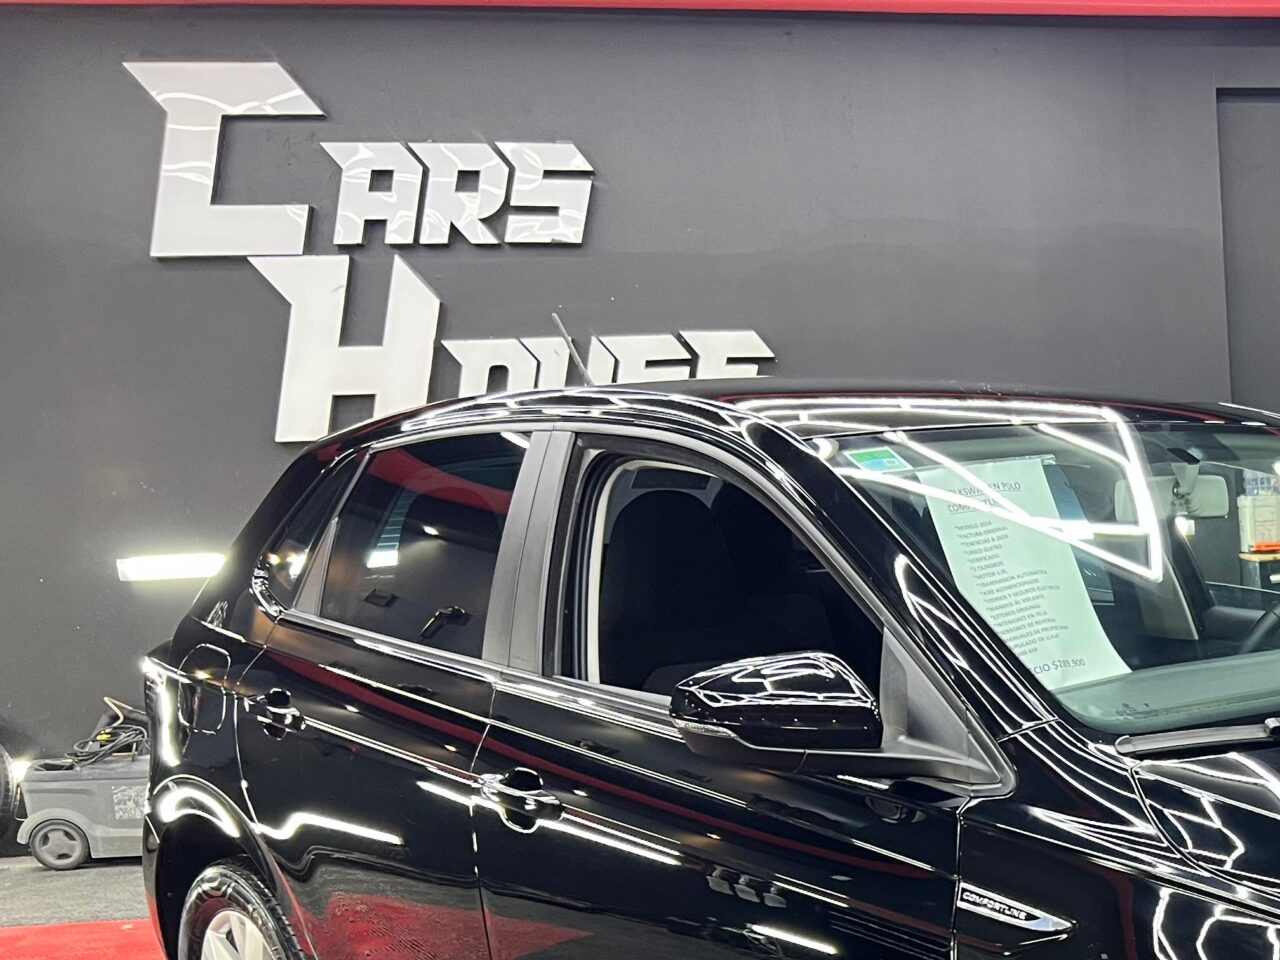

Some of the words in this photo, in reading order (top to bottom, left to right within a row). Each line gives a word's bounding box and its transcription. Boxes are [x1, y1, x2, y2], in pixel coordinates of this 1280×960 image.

[122, 61, 596, 258] CARS
[1001, 481, 1021, 490] POLO
[962, 891, 1028, 920] COMFORTLINE
